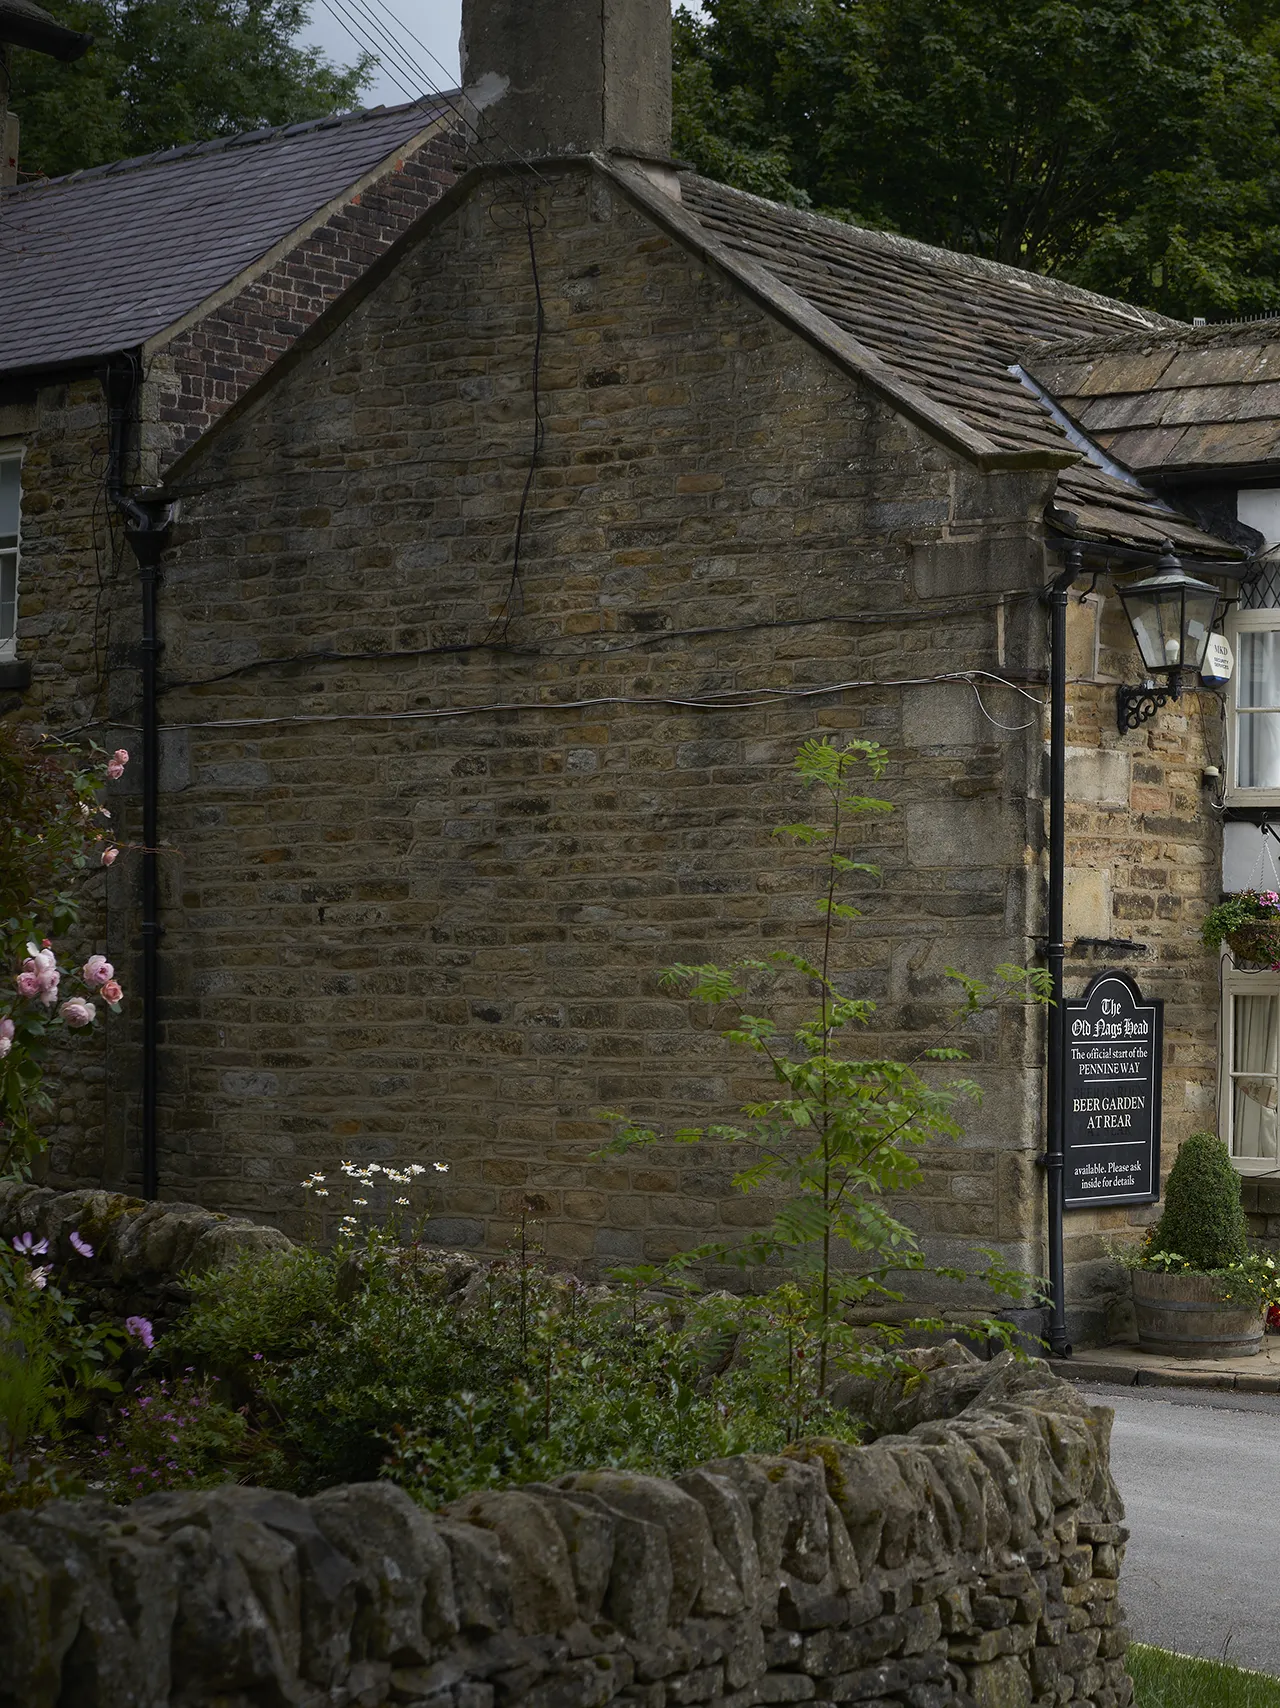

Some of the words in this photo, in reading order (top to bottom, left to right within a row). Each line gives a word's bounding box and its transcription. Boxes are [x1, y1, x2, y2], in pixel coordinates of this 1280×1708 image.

[1100, 998, 1122, 1018] The
[1071, 1018, 1091, 1036] Old
[1123, 1018, 1148, 1038] Head
[1070, 1048, 1086, 1060] The
[1086, 1047, 1112, 1060] official
[1112, 1048, 1128, 1059] start
[1128, 1047, 1137, 1058] of
[1136, 1046, 1148, 1058] the
[1079, 1063, 1120, 1076] PENNINE
[1120, 1062, 1140, 1074] WAY
[1072, 1098, 1100, 1112] BEER
[1102, 1096, 1146, 1111] GARDEN
[1086, 1115, 1102, 1129] AT
[1103, 1114, 1132, 1128] REAR
[1074, 1163, 1107, 1176] available.
[1108, 1162, 1130, 1174] Please
[1130, 1160, 1142, 1172] ask
[1081, 1177, 1102, 1190] inside
[1102, 1176, 1112, 1188] for
[1112, 1174, 1135, 1187] details
